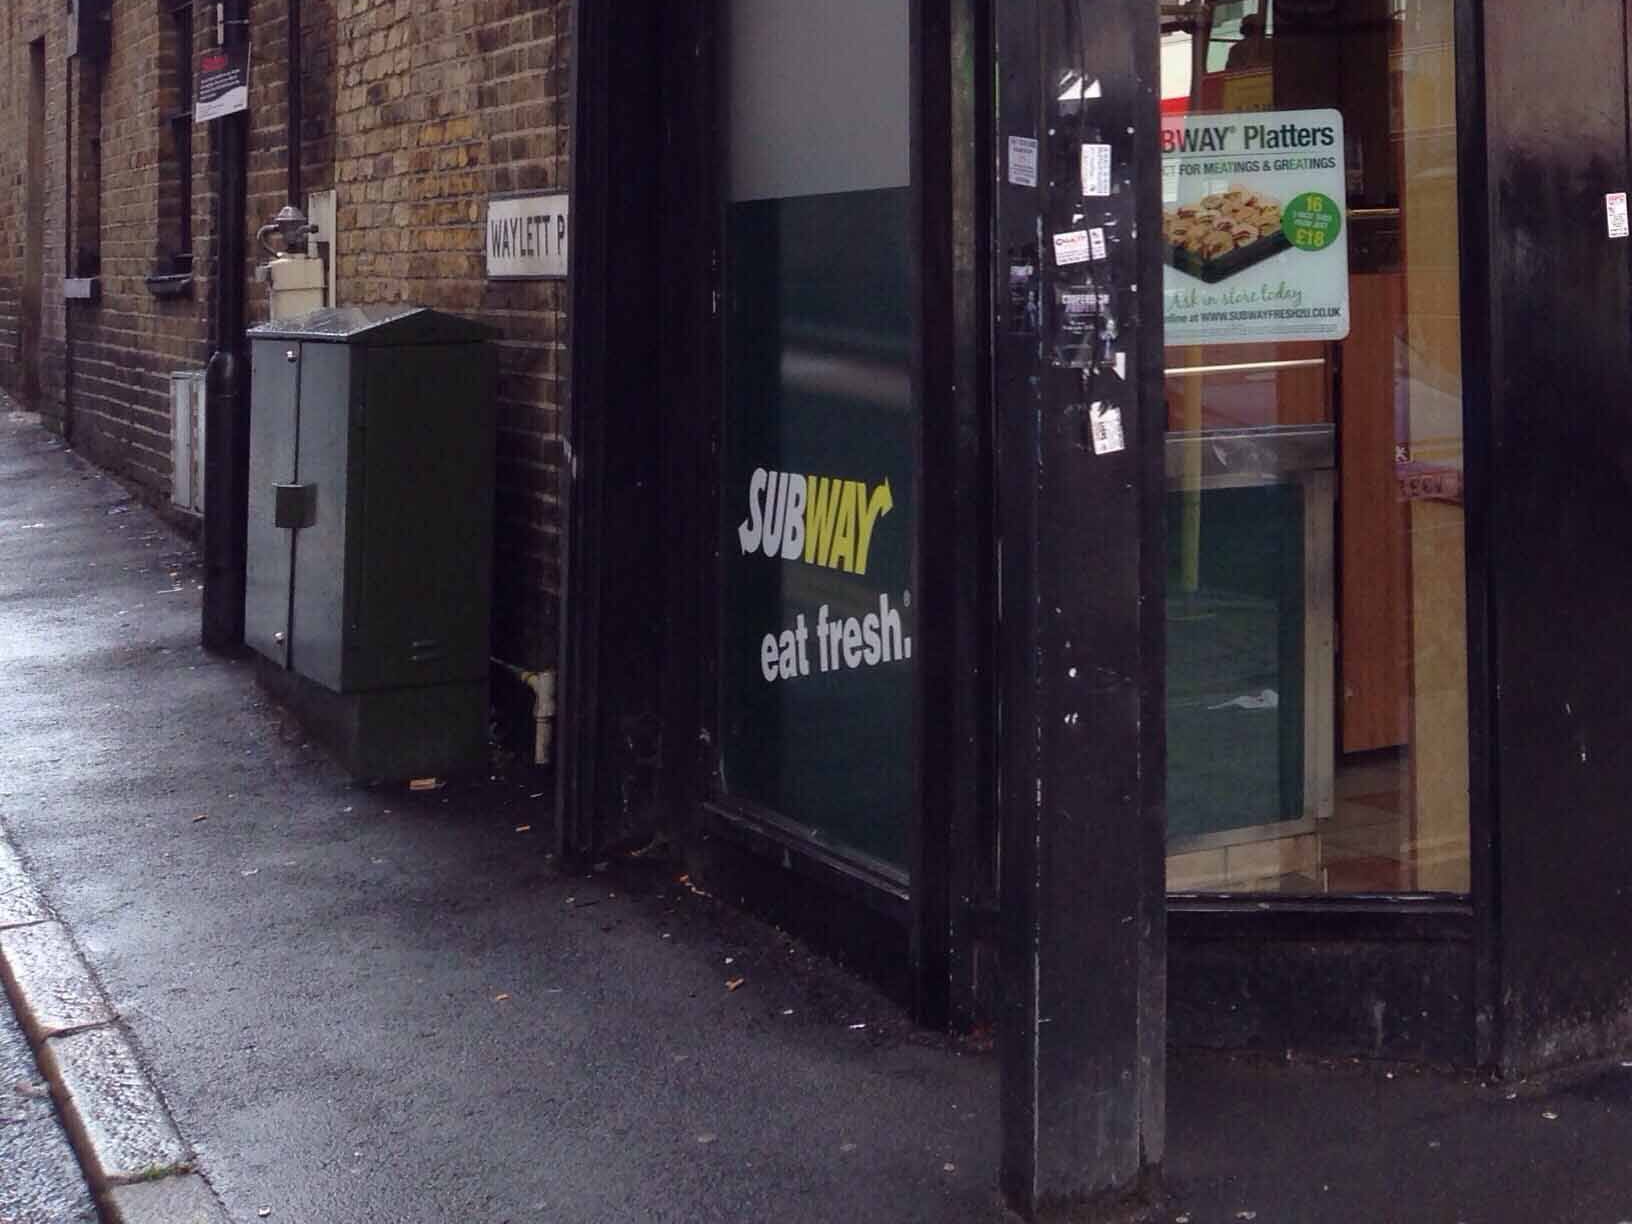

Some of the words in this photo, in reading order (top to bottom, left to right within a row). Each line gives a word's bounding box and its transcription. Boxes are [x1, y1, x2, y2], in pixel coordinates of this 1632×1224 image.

[1243, 123, 1335, 150] Platters
[1179, 163, 1201, 176] FOR
[1203, 160, 1261, 175] MEATINGS
[1262, 159, 1272, 172] &
[1273, 156, 1337, 172] GREATINGS
[490, 214, 552, 259] WAYLETT
[1260, 280, 1304, 308] today
[737, 467, 894, 576] SUBWAY
[760, 613, 811, 682] eat
[816, 592, 912, 673] fresh.
